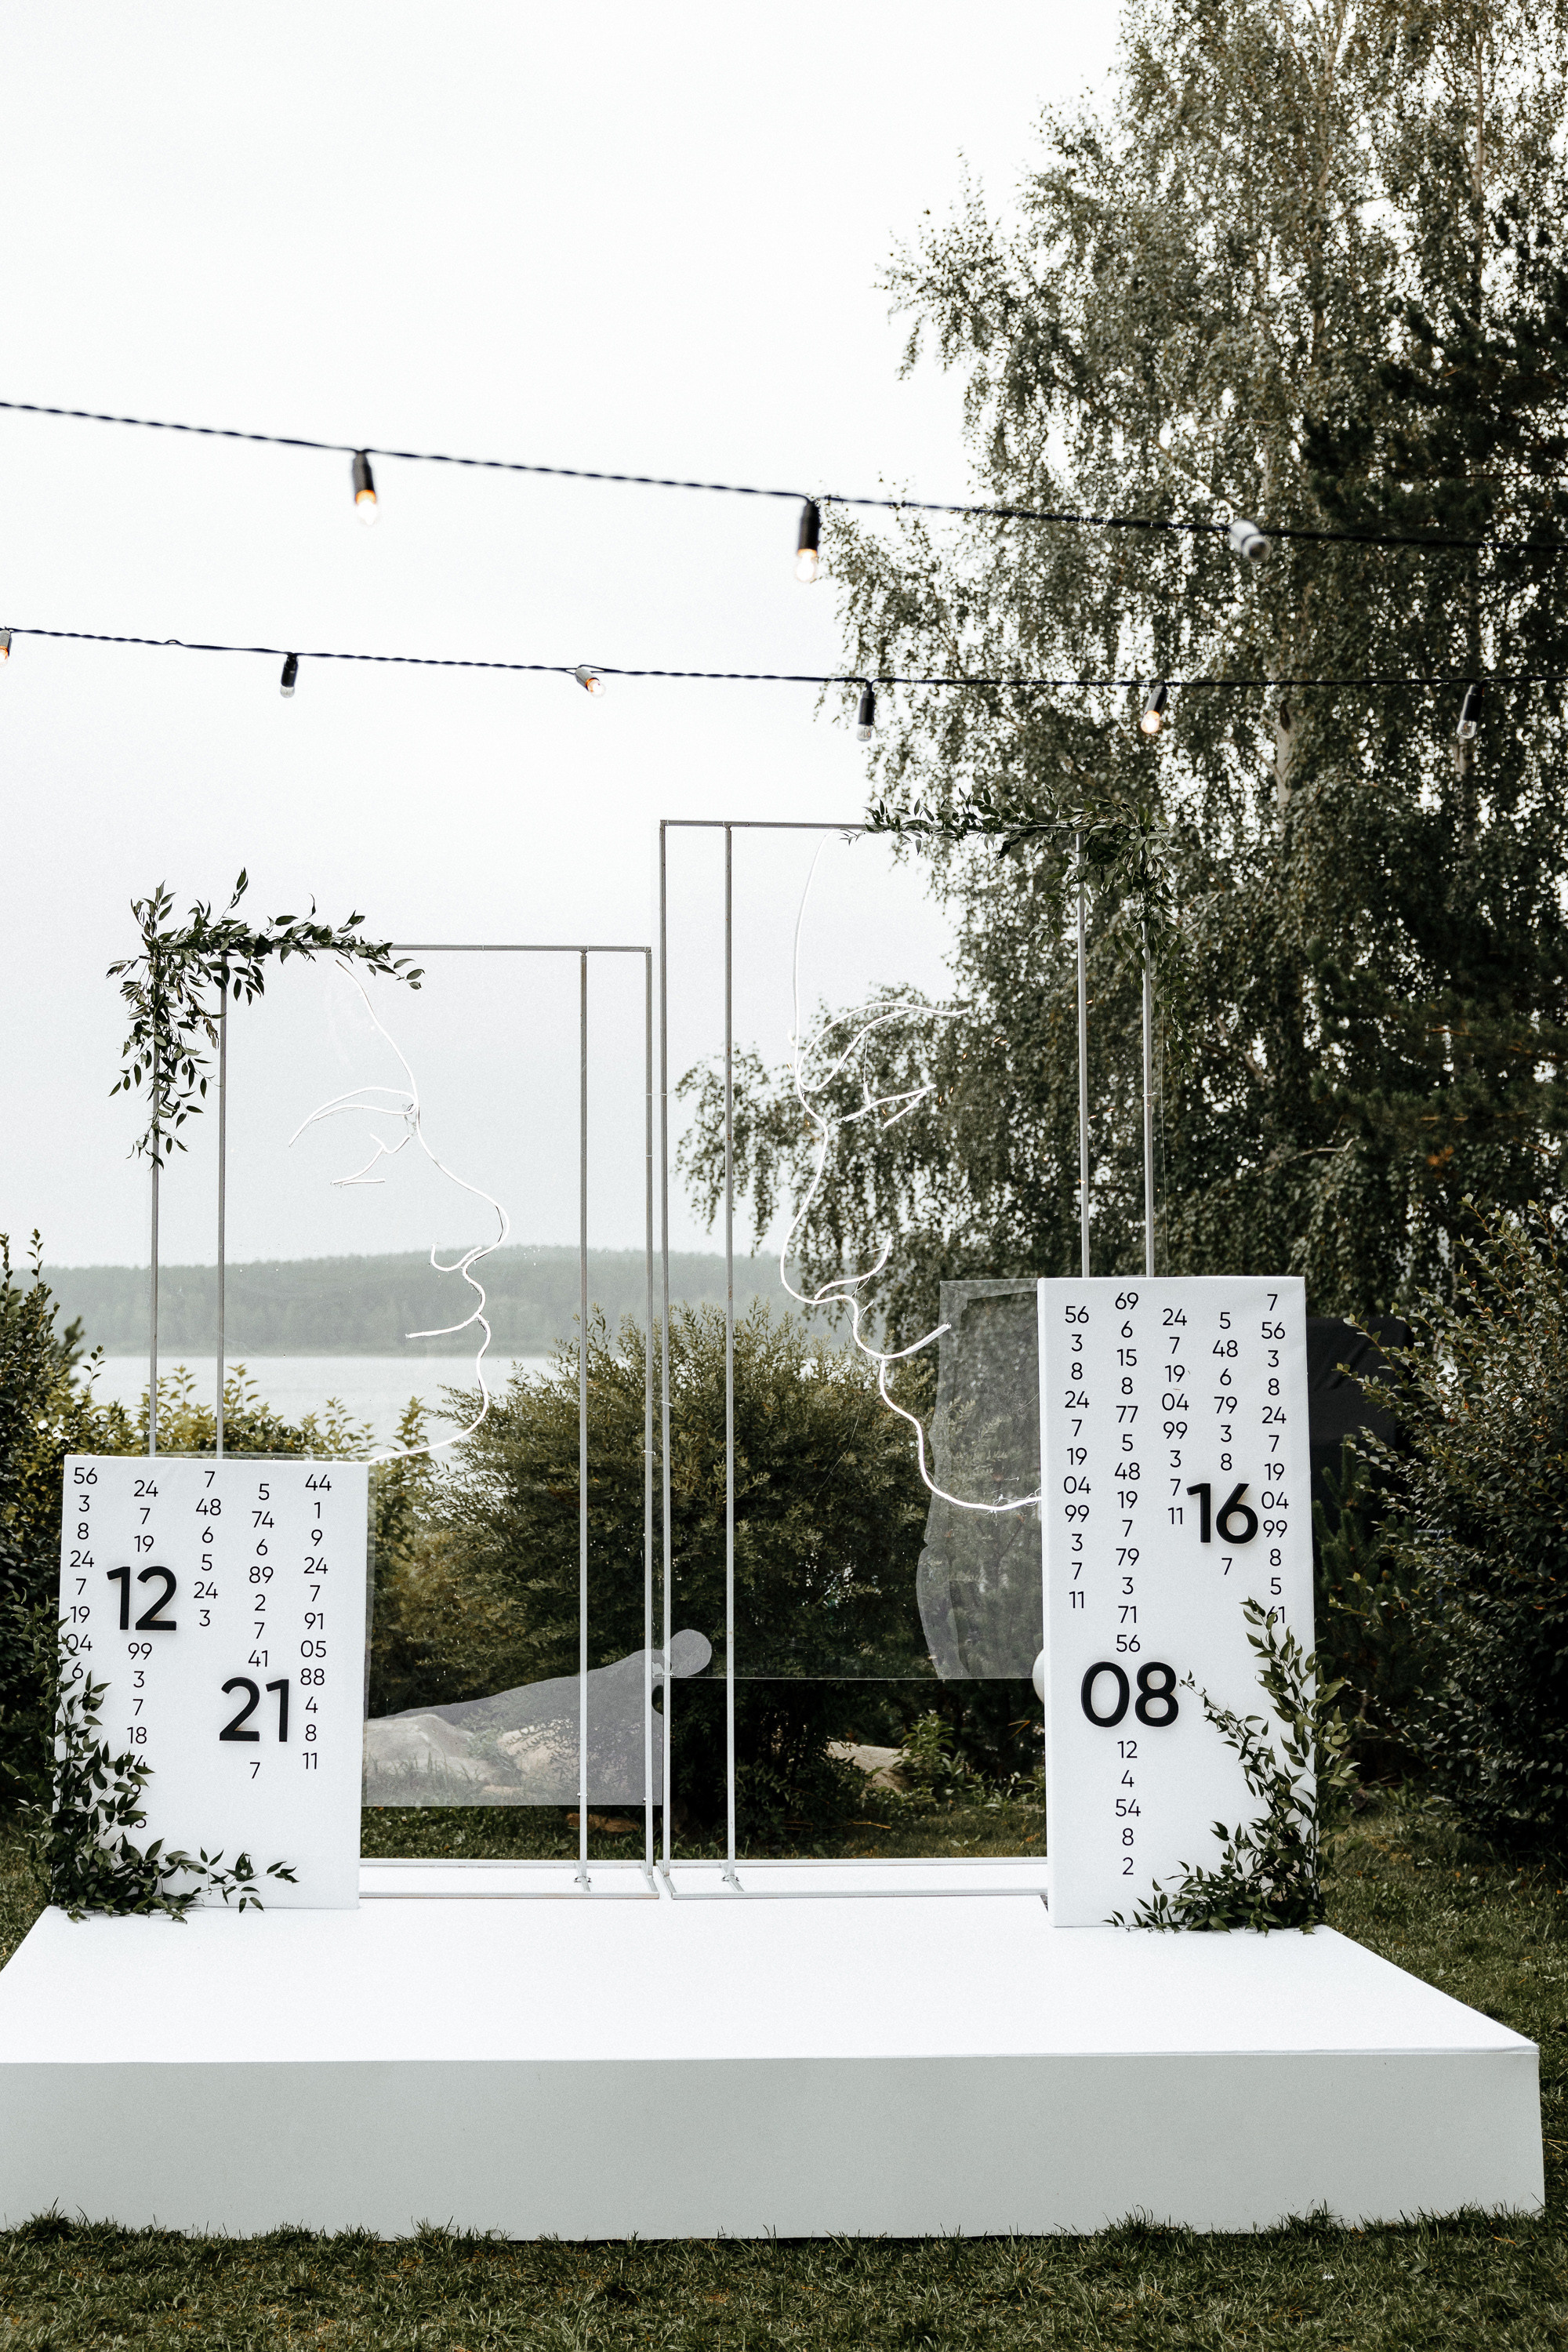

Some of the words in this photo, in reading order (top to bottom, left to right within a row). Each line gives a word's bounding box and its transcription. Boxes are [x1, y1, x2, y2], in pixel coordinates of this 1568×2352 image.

[1114, 1291, 1139, 1310] 69
[1266, 1293, 1279, 1312] 7
[1065, 1305, 1090, 1324] 56
[1162, 1308, 1188, 1327] 24
[1219, 1311, 1232, 1330] 5
[1120, 1320, 1134, 1338] 6
[1261, 1321, 1286, 1340] 56
[1071, 1334, 1083, 1352] 3
[1169, 1336, 1181, 1355] 7
[1212, 1339, 1239, 1358] 48
[1116, 1348, 1138, 1367] 15
[1267, 1349, 1279, 1368] 3
[1070, 1362, 1083, 1381] 8
[1164, 1364, 1185, 1383] 19
[1219, 1367, 1232, 1386] 6
[1121, 1377, 1134, 1396] 8
[1268, 1377, 1280, 1396] 8
[1064, 1390, 1090, 1409] 24
[1161, 1392, 1189, 1411] 04
[1214, 1396, 1238, 1414] 79
[1116, 1405, 1138, 1424] 77
[1261, 1406, 1287, 1425] 24
[1071, 1419, 1083, 1437] 7
[1163, 1421, 1188, 1439] 99
[1220, 1425, 1232, 1443] 3
[1121, 1433, 1134, 1452] 5
[1268, 1434, 1280, 1453] 7
[1066, 1447, 1087, 1466] 19
[1169, 1450, 1181, 1468] 3
[1220, 1453, 1232, 1472] 8
[73, 1467, 98, 1485] 56
[204, 1470, 216, 1488] 7
[1114, 1461, 1141, 1481] 48
[1264, 1462, 1285, 1481] 19
[133, 1479, 159, 1497] 24
[258, 1483, 270, 1501] 5
[305, 1473, 332, 1492] 44
[1063, 1475, 1091, 1494] 04
[1170, 1478, 1181, 1497] 7
[78, 1494, 90, 1512] 3
[195, 1497, 222, 1516] 48
[1116, 1490, 1138, 1509] 19
[1261, 1490, 1290, 1510] 04
[140, 1507, 151, 1525] 7
[251, 1510, 275, 1529] 74
[314, 1501, 321, 1519] 1
[1064, 1504, 1090, 1523] 99
[1167, 1507, 1183, 1525] 11
[1185, 1483, 1259, 1544] 16
[77, 1522, 89, 1541] 8
[201, 1526, 214, 1544] 6
[1122, 1519, 1134, 1537] 7
[1262, 1519, 1288, 1538] 99
[133, 1534, 154, 1553] 19
[256, 1538, 268, 1556] 6
[310, 1529, 323, 1547] 9
[1071, 1533, 1083, 1552] 3
[69, 1549, 95, 1568] 24
[201, 1553, 212, 1572] 5
[303, 1556, 328, 1574] 24
[1115, 1548, 1140, 1566] 79
[1221, 1557, 1233, 1576] 7
[1269, 1548, 1282, 1567] 8
[249, 1566, 274, 1584] 89
[1071, 1562, 1083, 1581] 7
[75, 1577, 87, 1595] 7
[193, 1581, 219, 1599] 24
[310, 1584, 321, 1602] 7
[1122, 1577, 1134, 1595] 3
[1270, 1577, 1282, 1595] 5
[106, 1565, 177, 1632] 12
[254, 1593, 266, 1612] 2
[1069, 1591, 1084, 1609] 11
[70, 1606, 91, 1624] 19
[198, 1609, 211, 1628] 3
[304, 1612, 324, 1630] 91
[1117, 1605, 1137, 1624] 71
[1265, 1605, 1286, 1624] 61
[254, 1621, 265, 1639] 7
[65, 1633, 93, 1652] 04
[128, 1642, 153, 1661] 99
[300, 1639, 327, 1658] 05
[1116, 1634, 1141, 1653] 56
[248, 1650, 268, 1668] 41
[71, 1661, 84, 1680] 6
[132, 1670, 145, 1689] 3
[299, 1668, 325, 1686] 88
[1080, 1661, 1179, 1728] 08
[132, 1698, 144, 1716] 7
[219, 1676, 290, 1743] 21
[305, 1696, 318, 1714] 4
[126, 1726, 147, 1744] 18
[305, 1723, 317, 1742] 8
[1116, 1740, 1138, 1759] 12
[302, 1751, 318, 1770] 11
[249, 1762, 261, 1780] 7
[1120, 1769, 1135, 1788] 4
[1115, 1798, 1142, 1817] 54
[1122, 1828, 1134, 1846] 8
[1122, 1857, 1134, 1875] 2
